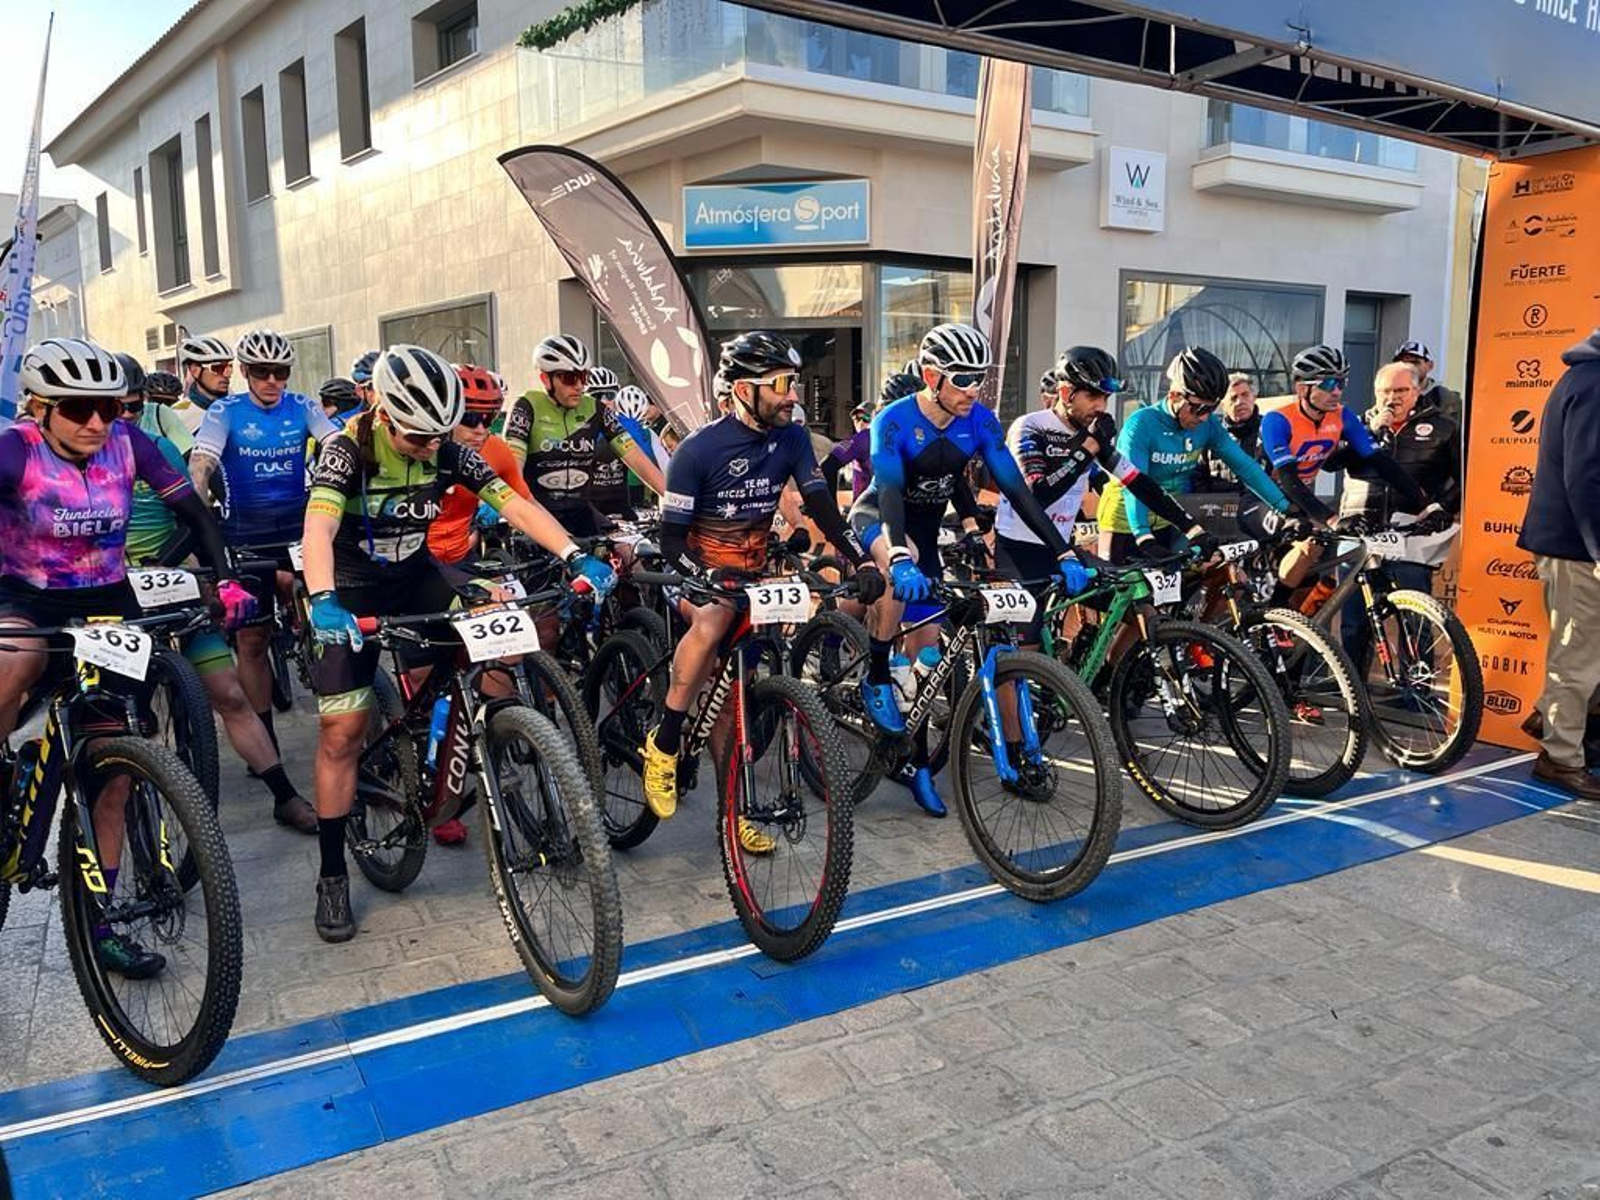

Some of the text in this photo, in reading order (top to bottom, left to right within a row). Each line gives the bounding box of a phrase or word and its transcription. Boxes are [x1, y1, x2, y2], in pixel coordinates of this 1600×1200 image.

[1115, 194, 1135, 205] Wind
[695, 196, 860, 231] Atmósfera Sport
[1505, 379, 1553, 388] mimaflor
[140, 572, 186, 591] 332
[758, 588, 801, 605] 313
[993, 593, 1028, 609] 304
[470, 615, 524, 640] 362
[1478, 626, 1538, 641] HUELVA MOTOR
[85, 629, 141, 653] 363
[1482, 655, 1528, 675] GOBIK
[1486, 694, 1518, 711] BLUB
